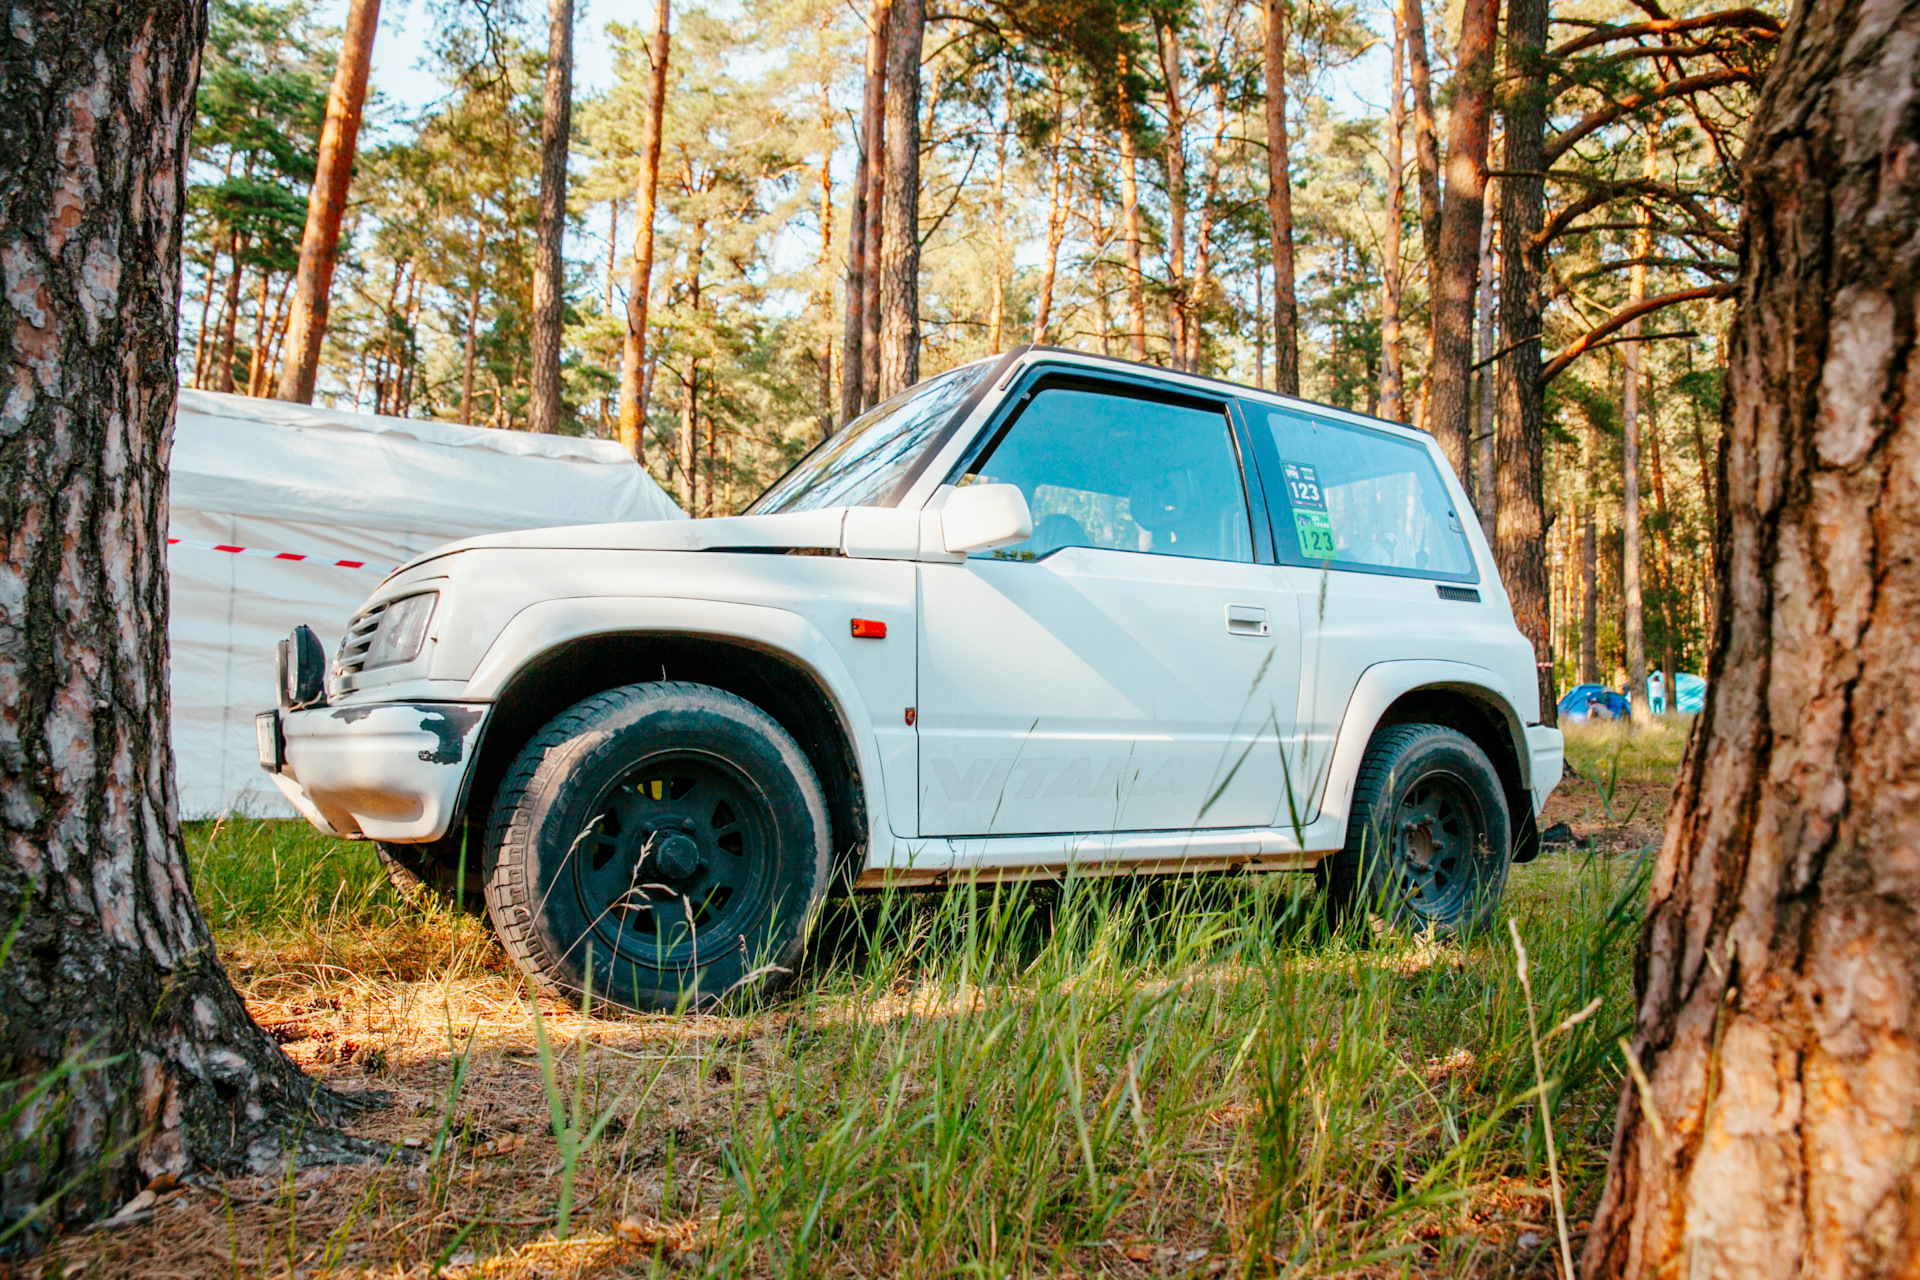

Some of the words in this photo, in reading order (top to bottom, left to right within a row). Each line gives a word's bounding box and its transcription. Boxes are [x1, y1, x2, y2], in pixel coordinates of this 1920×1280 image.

[1291, 481, 1320, 501] 123
[1301, 530, 1333, 551] 123
[931, 756, 1185, 802] VITARA
